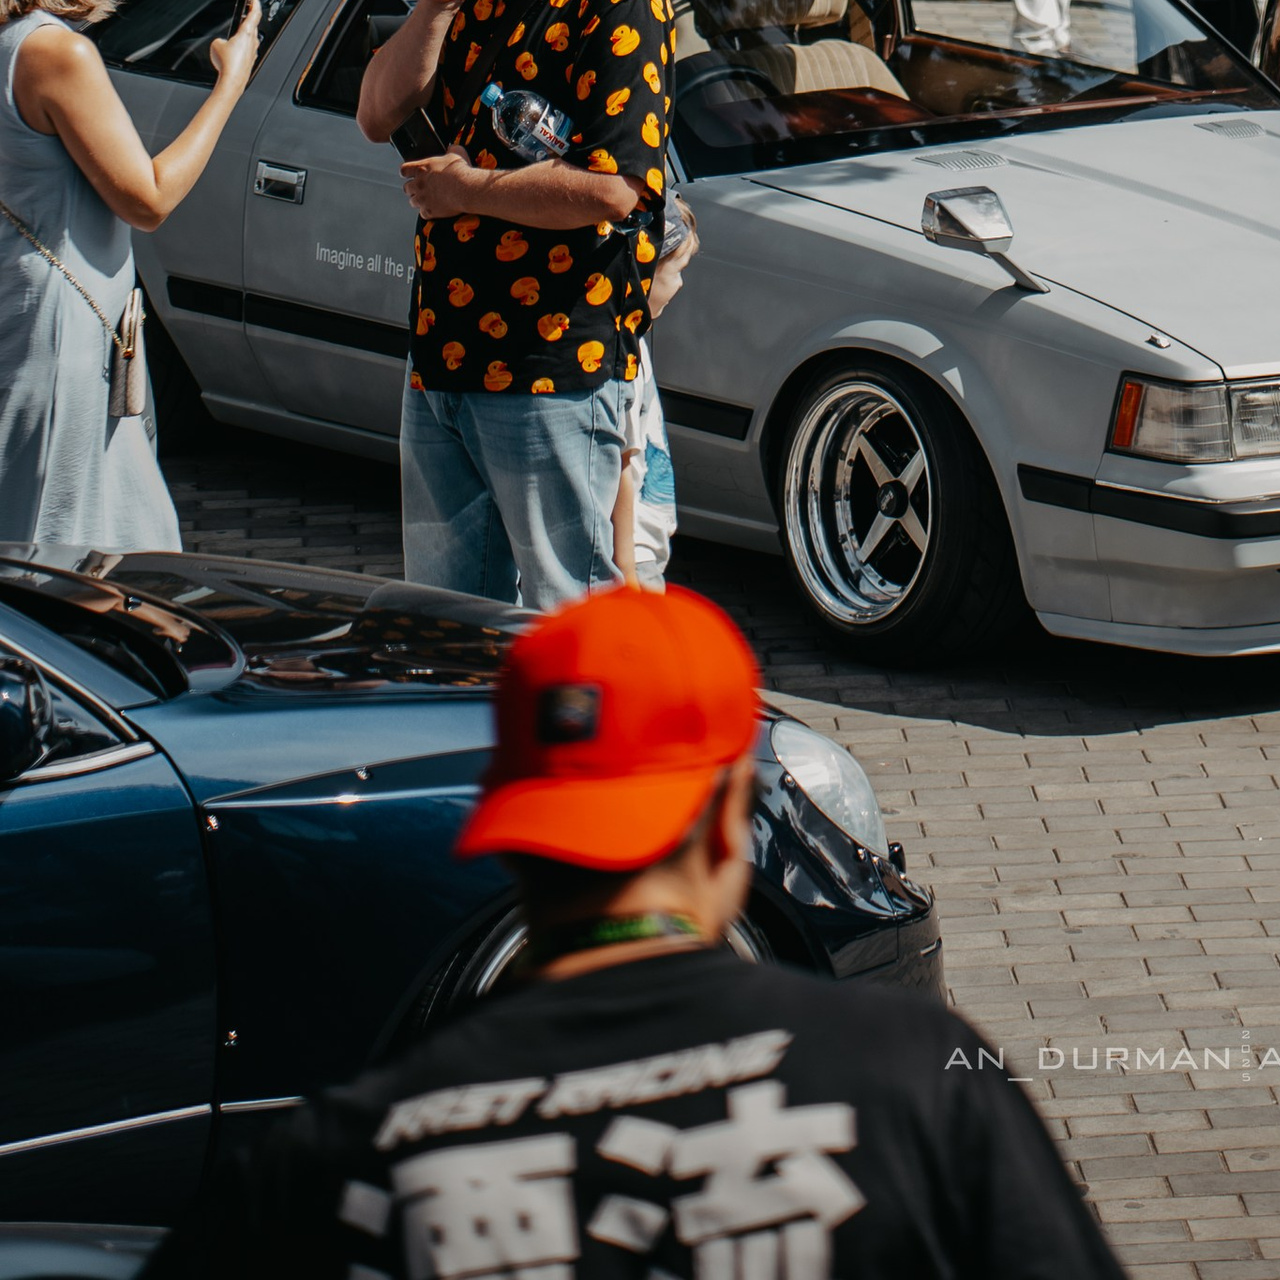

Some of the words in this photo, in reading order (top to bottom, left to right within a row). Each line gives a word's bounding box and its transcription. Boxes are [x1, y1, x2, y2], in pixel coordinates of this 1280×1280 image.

[540, 126, 566, 150] BAIKAL
[316, 242, 364, 270] Imagine
[367, 255, 381, 273] all
[385, 257, 404, 278] the
